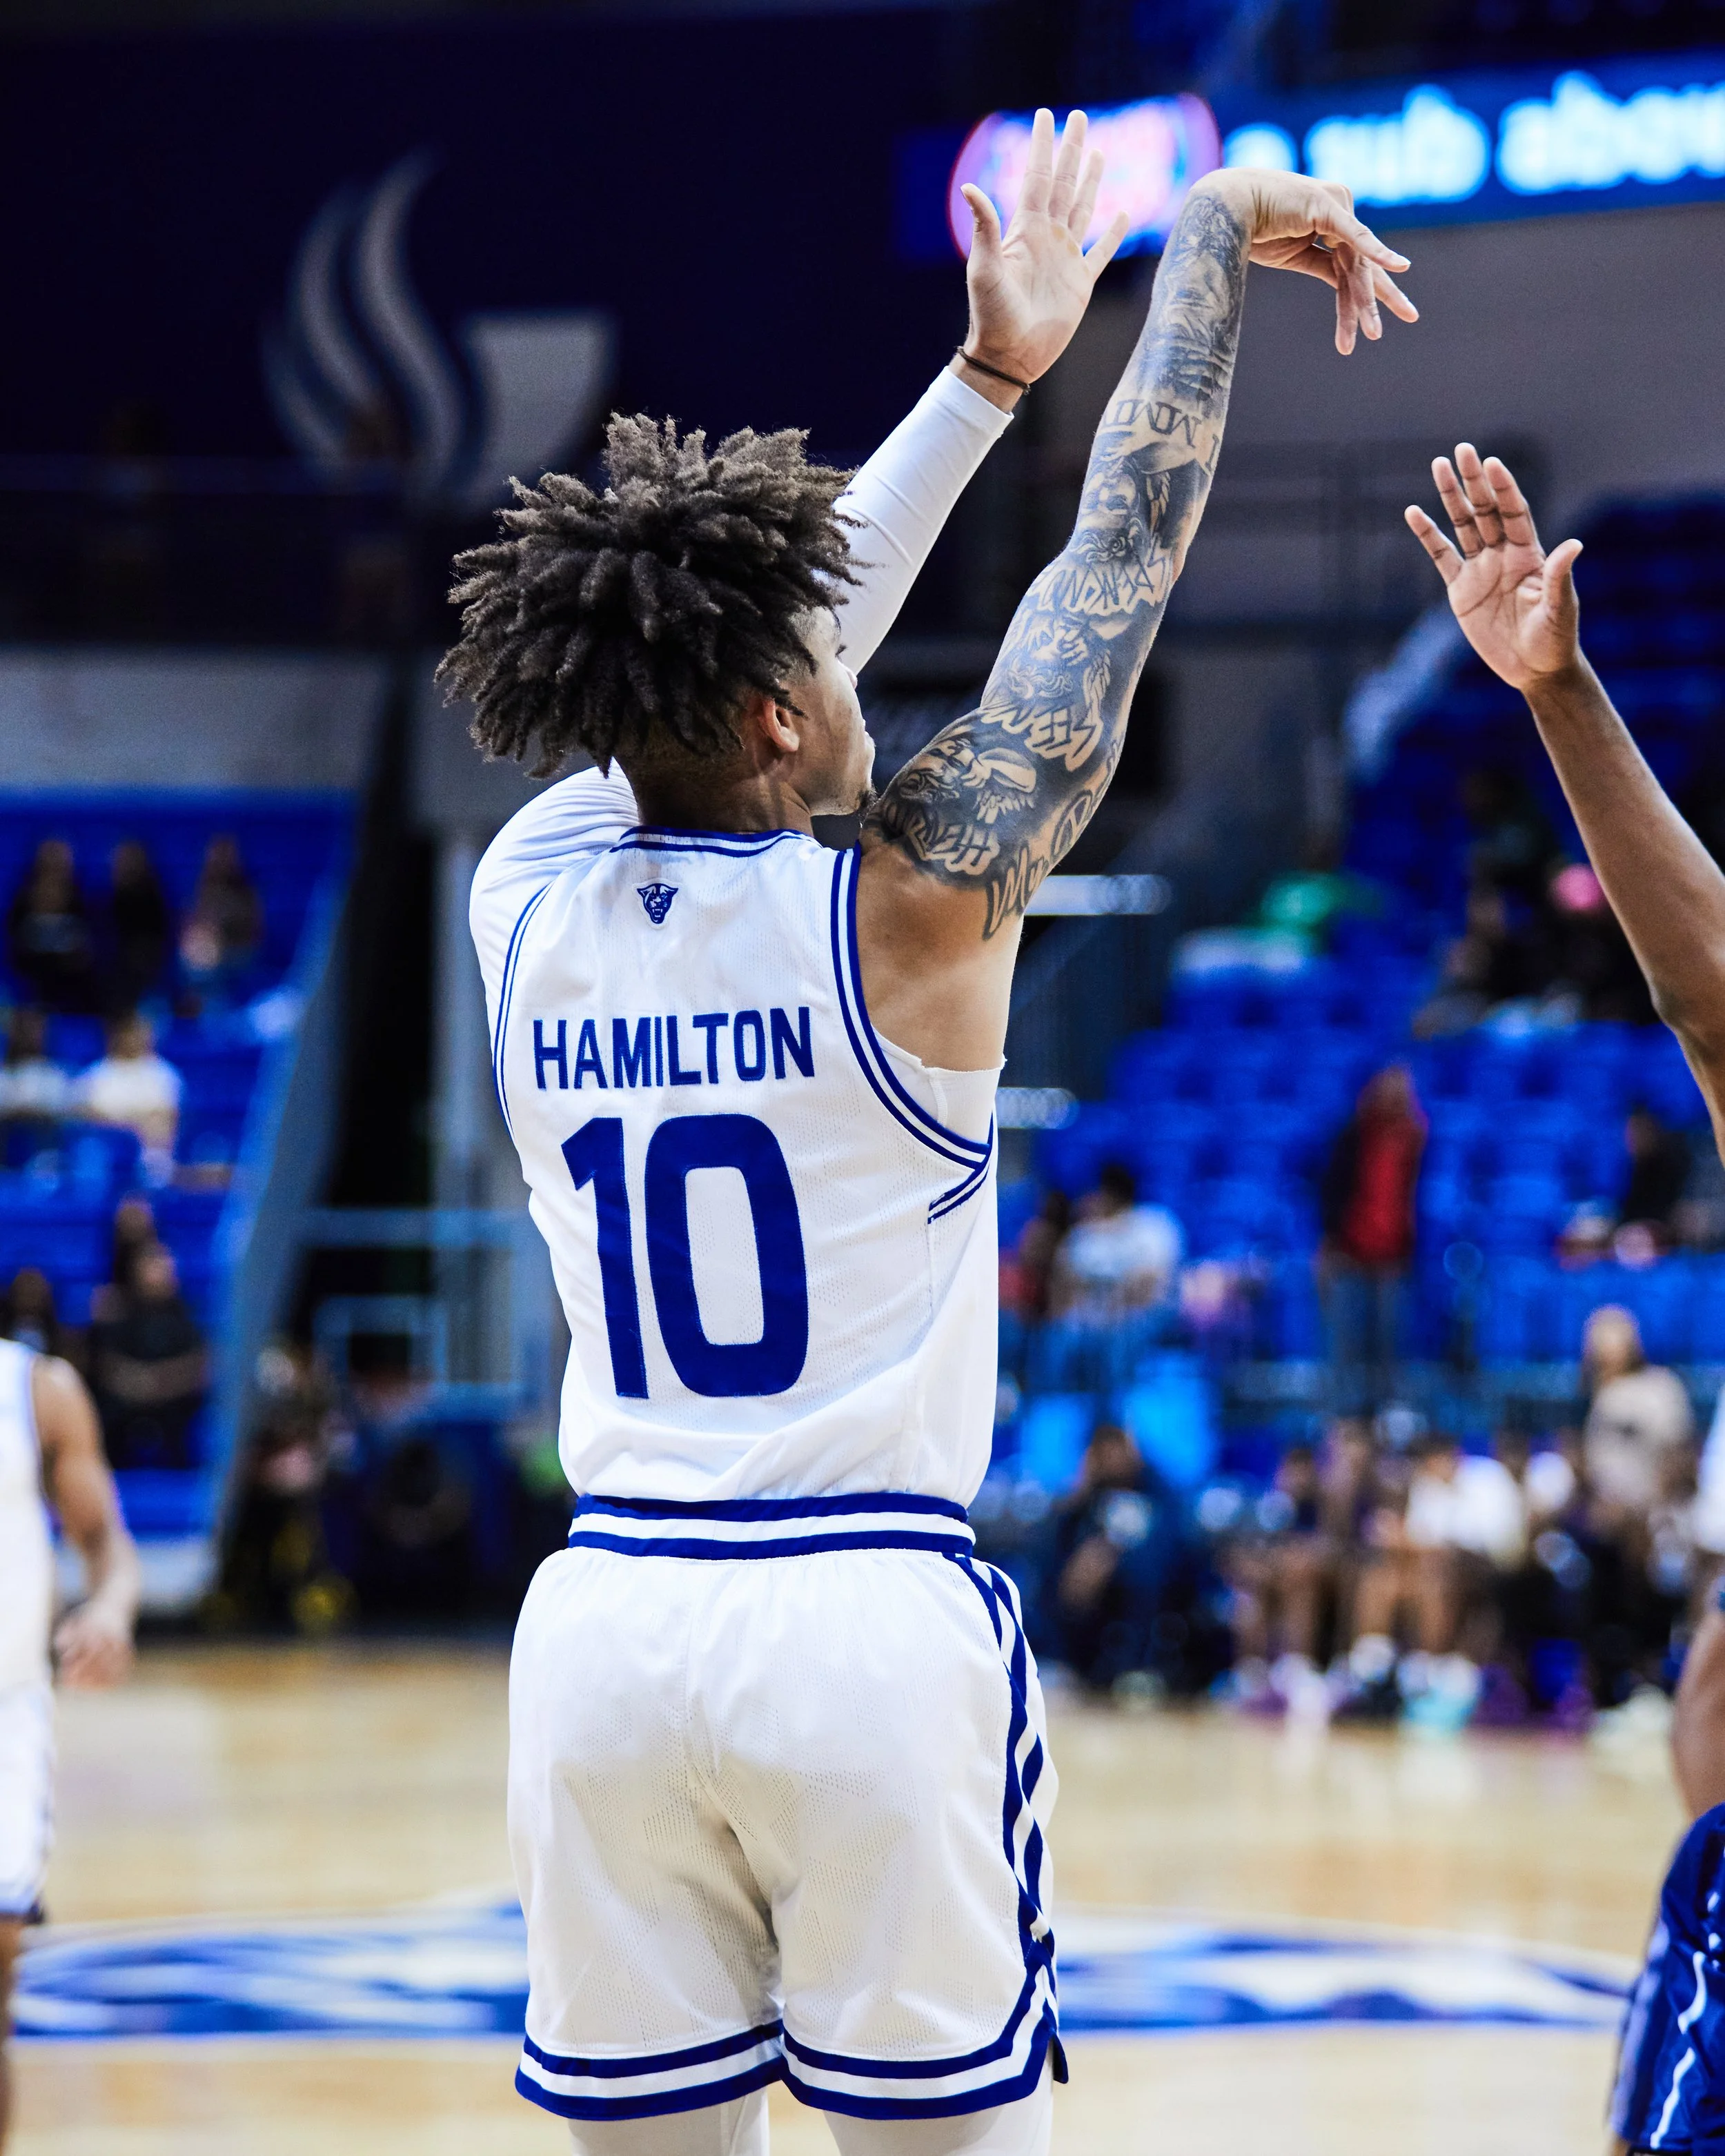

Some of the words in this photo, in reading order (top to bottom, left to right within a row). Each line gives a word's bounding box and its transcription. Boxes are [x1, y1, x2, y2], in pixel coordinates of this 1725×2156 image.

[1032, 704, 1096, 758] SEE
[533, 1007, 815, 1090] HAMILTON
[561, 1113, 809, 1399] 10
